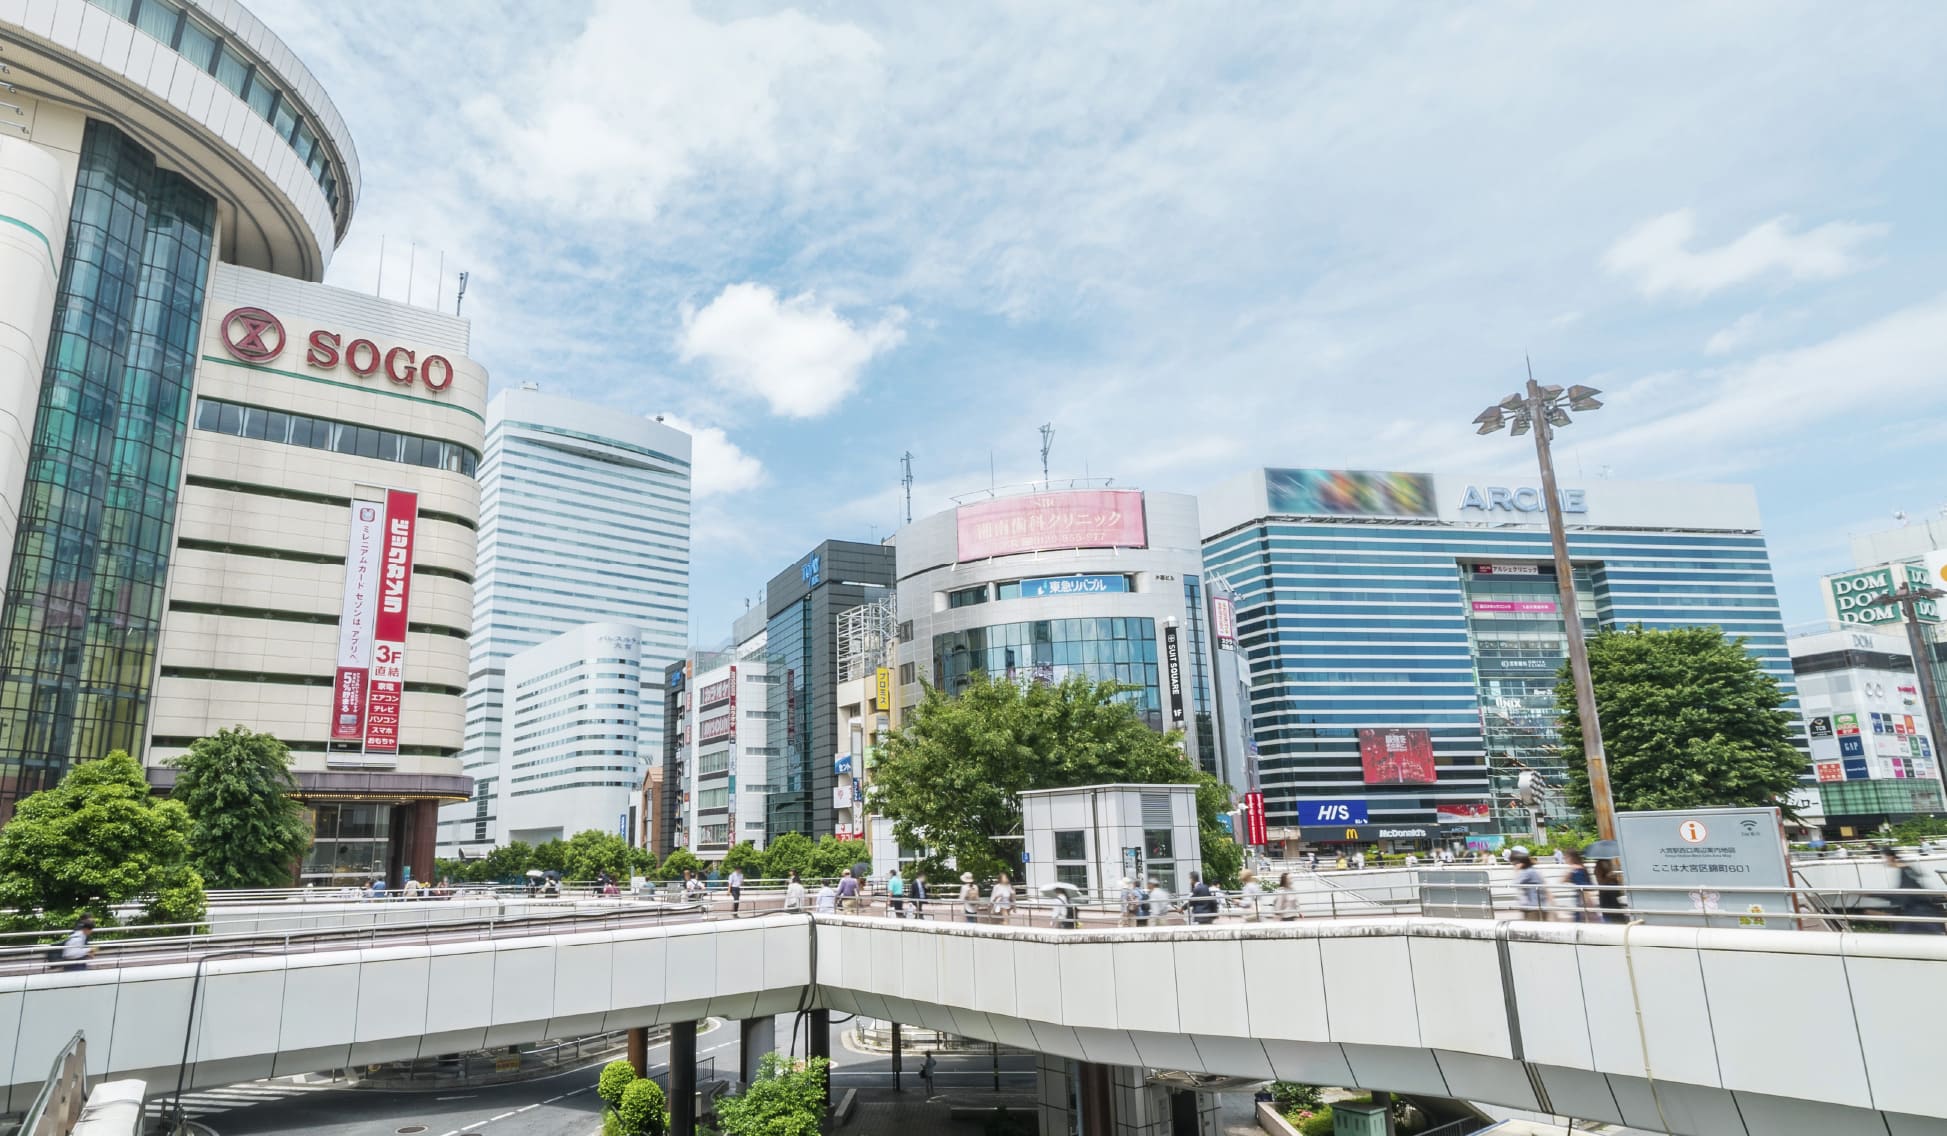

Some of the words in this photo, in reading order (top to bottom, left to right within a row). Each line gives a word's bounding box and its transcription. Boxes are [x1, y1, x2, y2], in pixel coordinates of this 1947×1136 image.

[306, 330, 454, 392] SOGO
[383, 518, 409, 614] ビックカメラ
[1911, 570, 1927, 583] DO
[1049, 579, 1107, 592] 東急リバブル
[1834, 572, 1888, 595] DOM
[1842, 604, 1896, 624] DOM
[1919, 602, 1936, 616] DO
[376, 645, 401, 664] 3F
[1169, 644, 1177, 661] SUIT
[375, 666, 400, 677] 直結
[1170, 662, 1180, 696] SQUARE
[371, 694, 399, 703] エアコン
[373, 705, 395, 713] テレビ
[1173, 709, 1182, 718] 1F
[369, 715, 398, 724] パソコン
[371, 726, 393, 734] スマホ
[367, 737, 395, 745] おもちゃ
[1844, 742, 1859, 752] GAP
[1317, 805, 1350, 821] HIS
